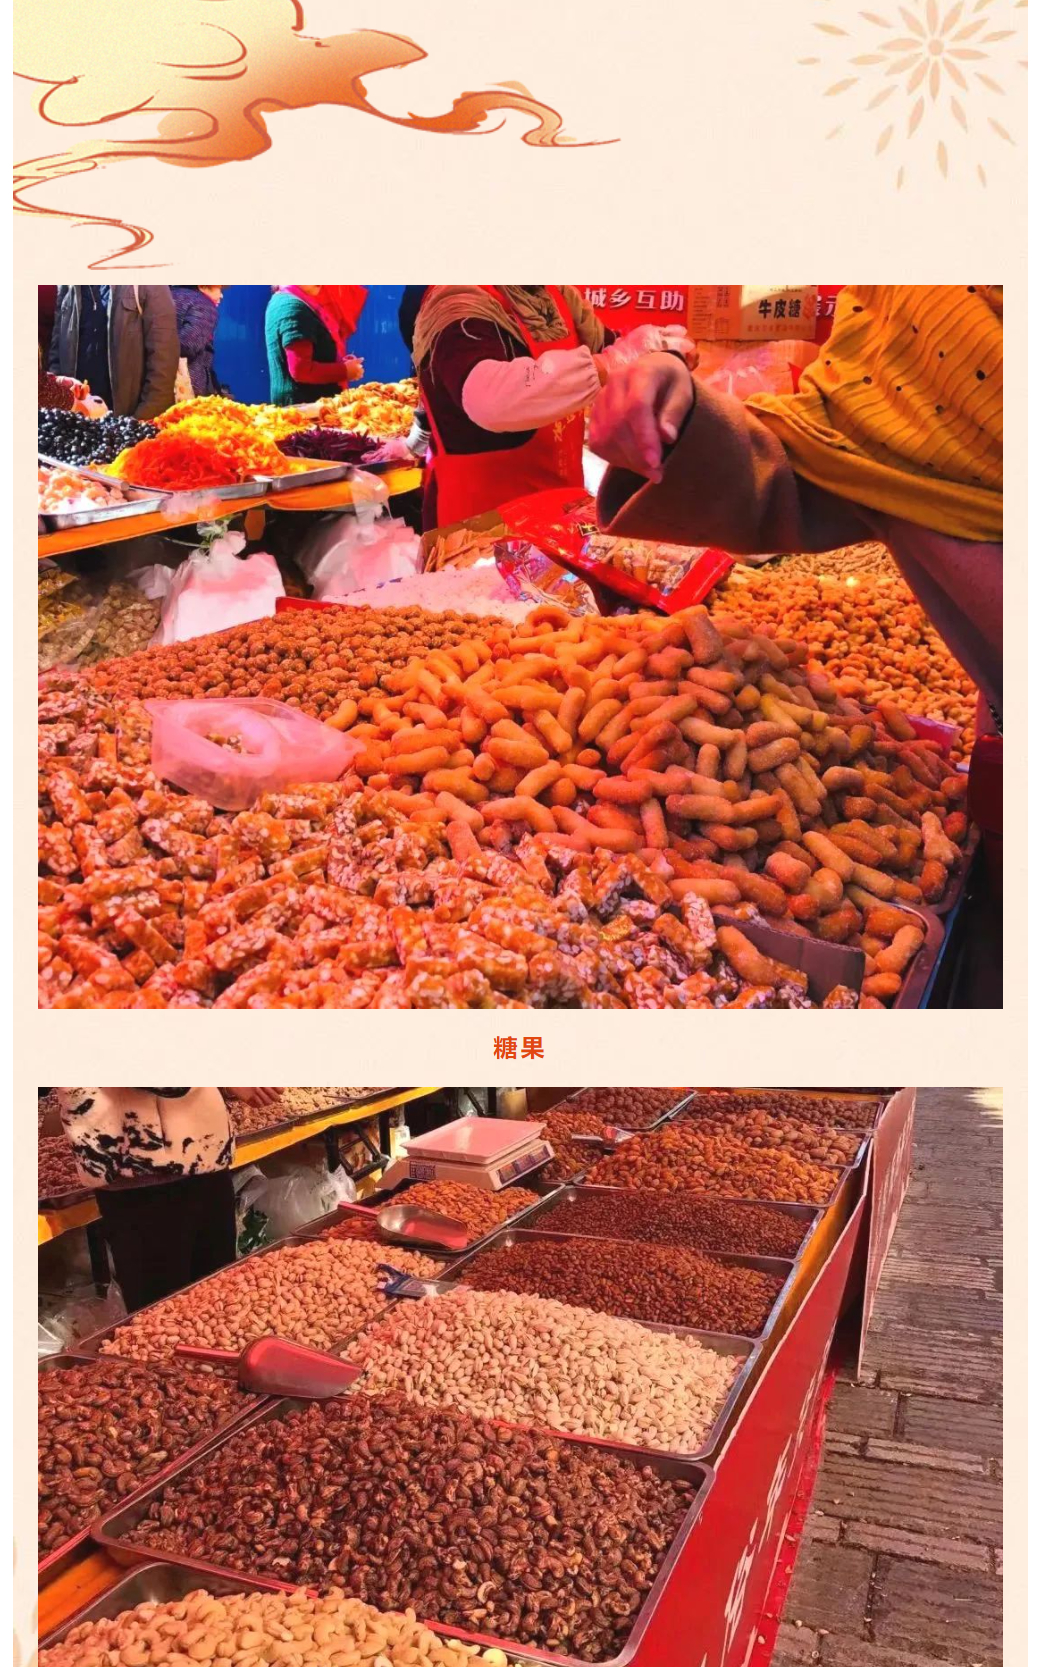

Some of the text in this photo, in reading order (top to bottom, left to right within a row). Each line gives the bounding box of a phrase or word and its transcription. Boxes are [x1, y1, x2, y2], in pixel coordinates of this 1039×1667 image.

[584, 287, 684, 311] 城乡互助
[758, 298, 801, 319] 牛皮糖
